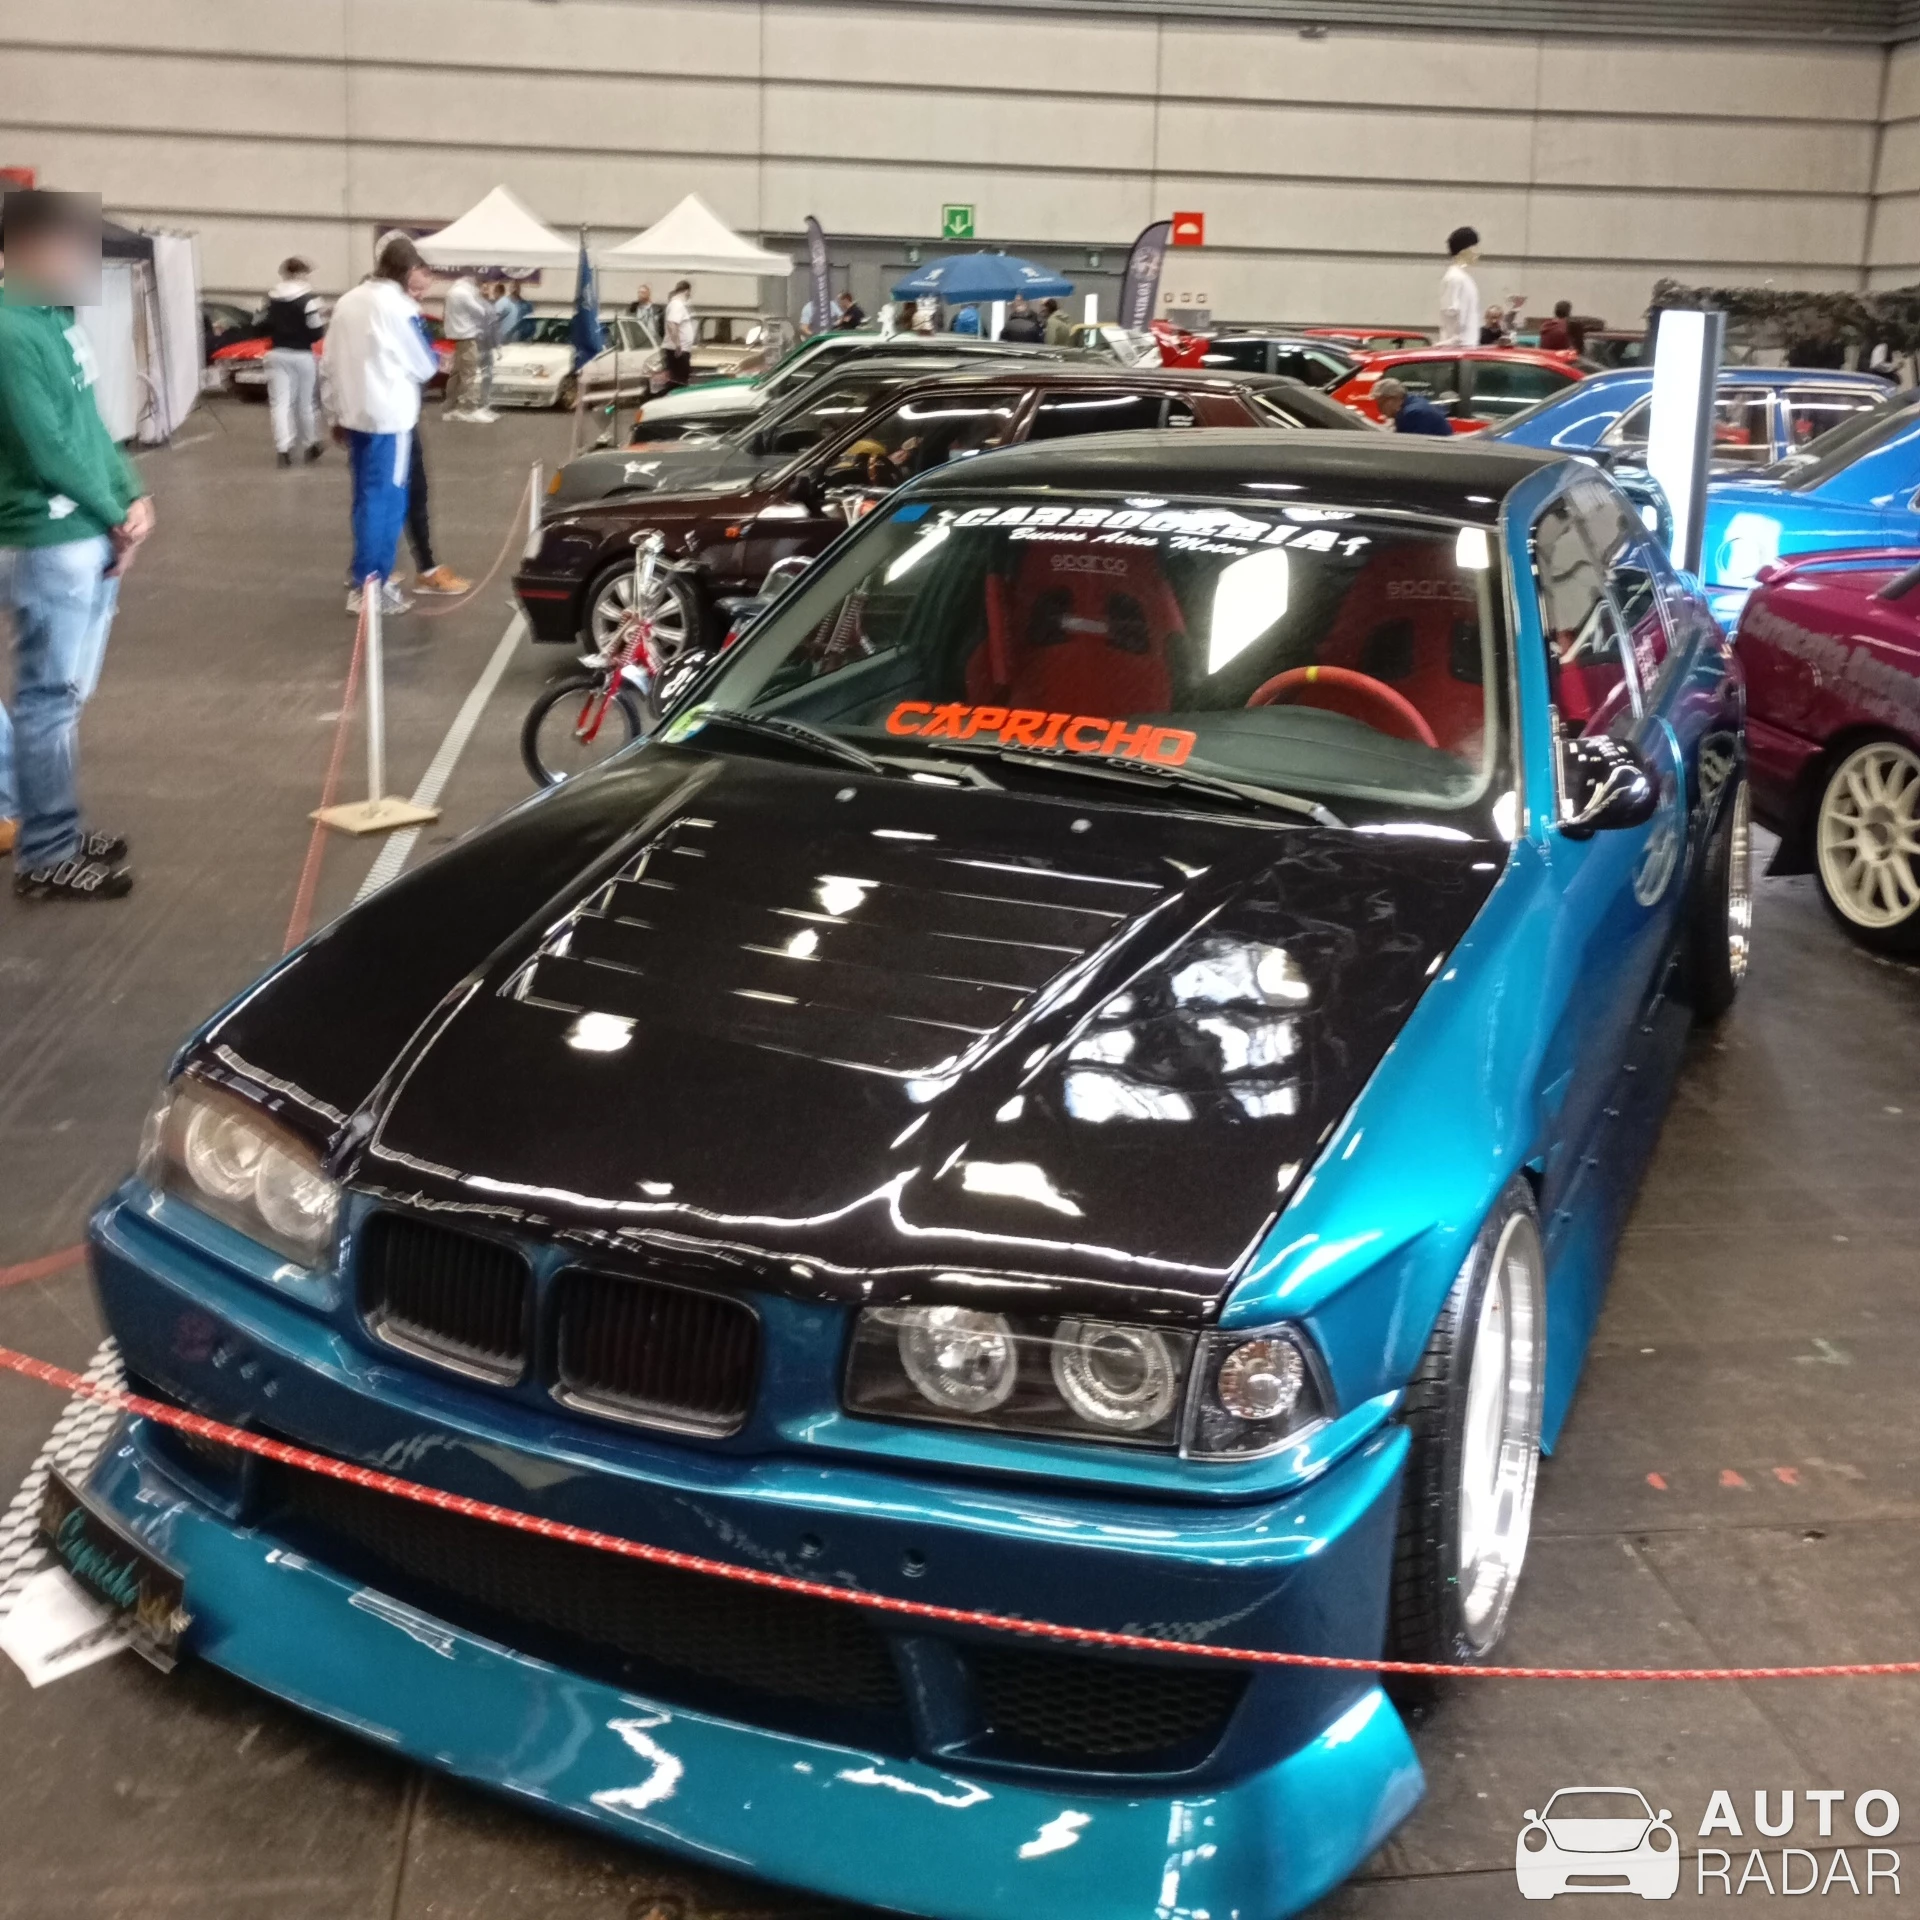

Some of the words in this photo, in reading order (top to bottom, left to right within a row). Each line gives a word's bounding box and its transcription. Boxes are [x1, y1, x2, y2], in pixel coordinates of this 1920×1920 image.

[1009, 526, 1087, 541] Buenos
[1090, 531, 1159, 546] Aires
[1169, 535, 1249, 556] Motor
[885, 701, 1197, 767] CAPRICHO
